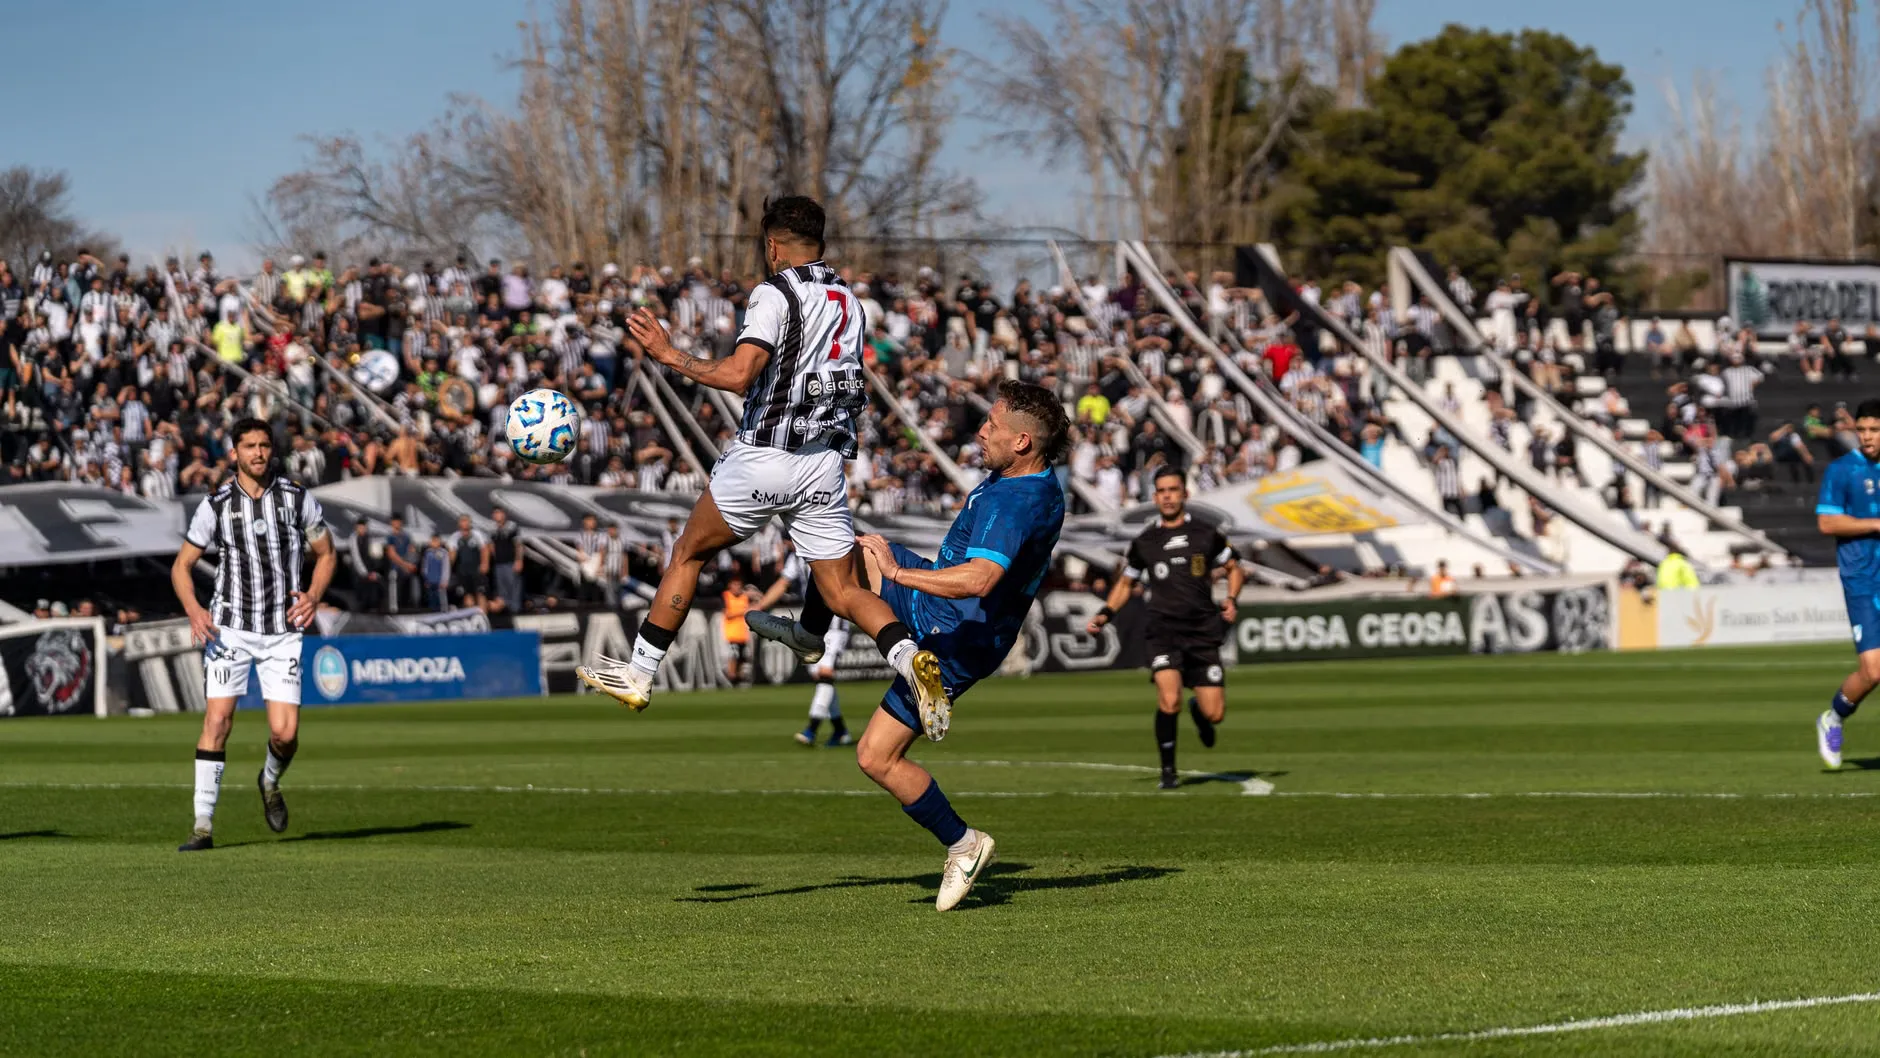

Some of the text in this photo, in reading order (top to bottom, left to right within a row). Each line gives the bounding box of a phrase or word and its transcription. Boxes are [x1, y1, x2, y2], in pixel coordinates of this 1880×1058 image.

[826, 288, 848, 360] 7
[1238, 611, 1467, 651] CEOSA CEOSA
[352, 656, 466, 685] MENDOZA
